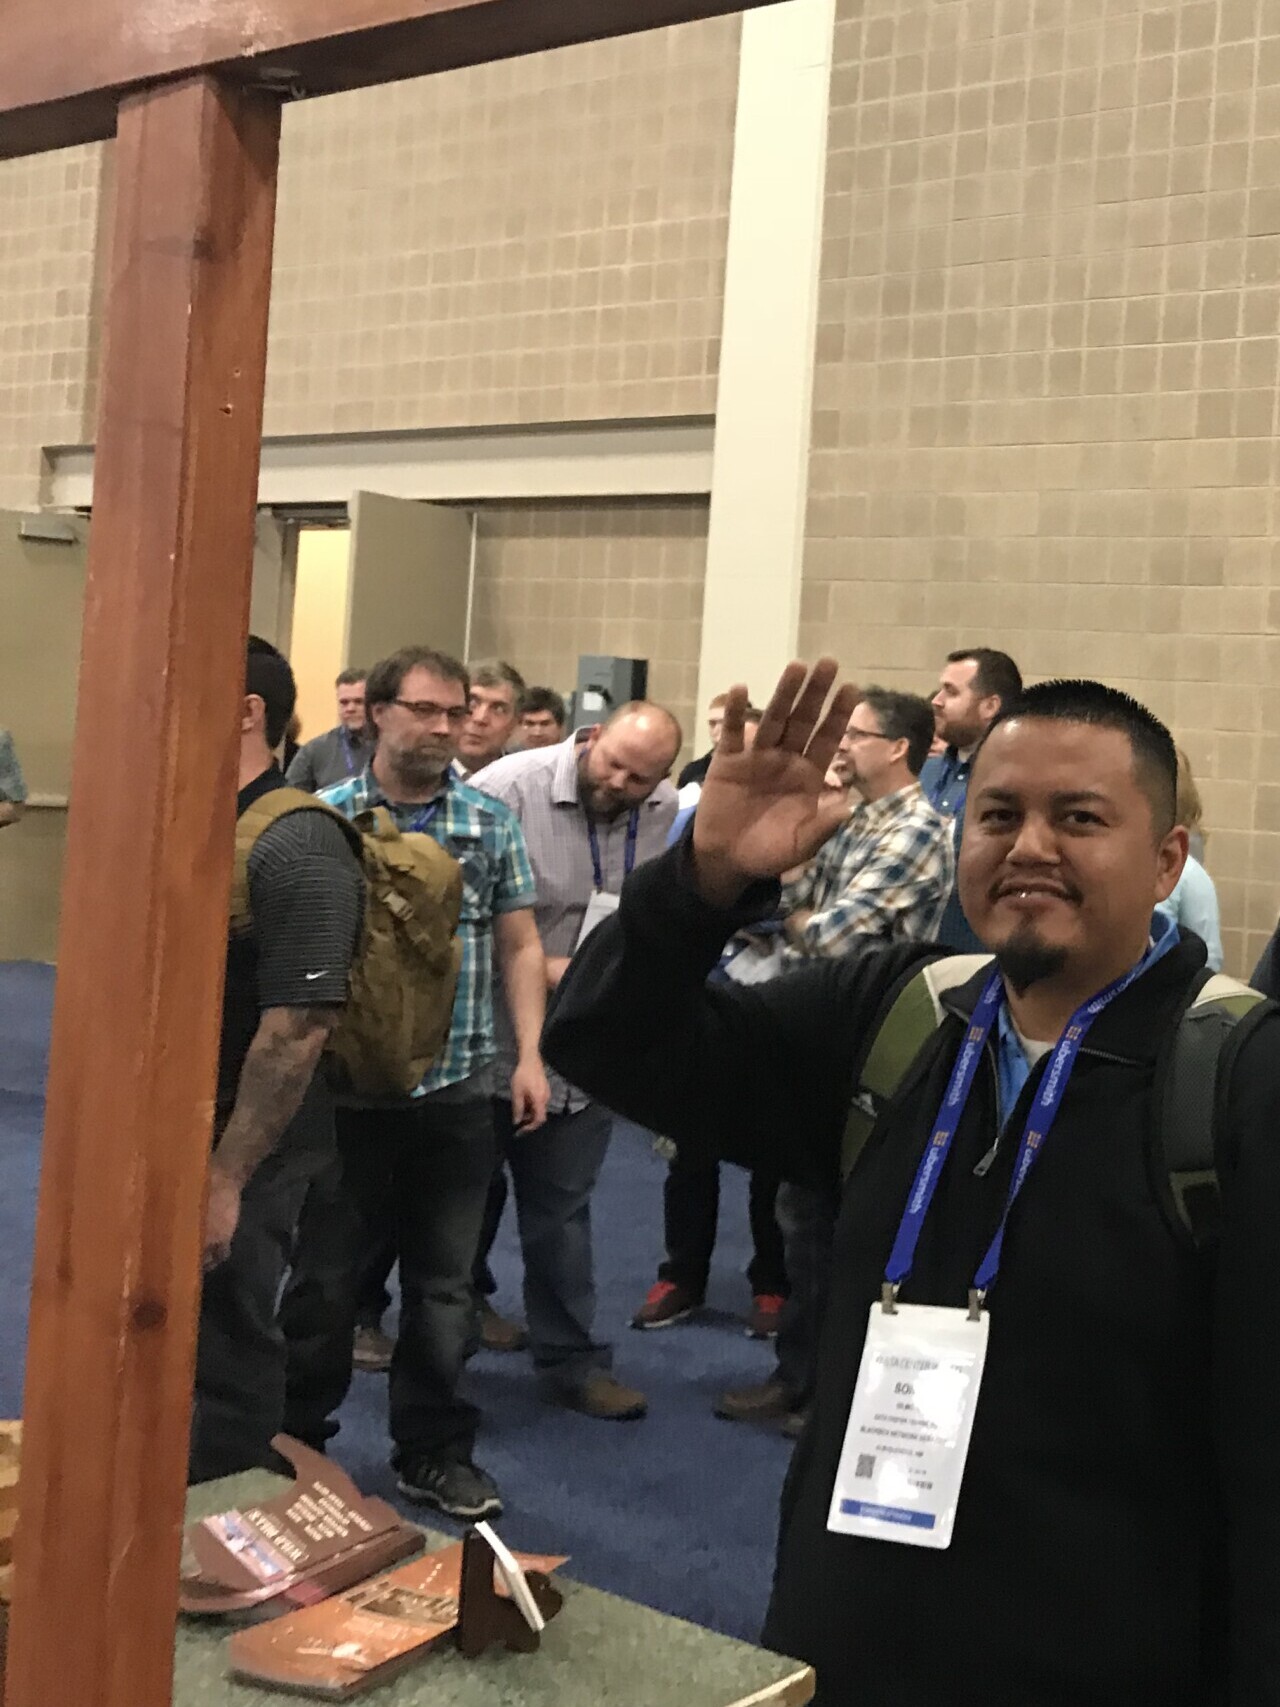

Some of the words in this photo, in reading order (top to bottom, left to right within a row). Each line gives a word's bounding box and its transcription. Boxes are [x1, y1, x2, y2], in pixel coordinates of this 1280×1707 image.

[947, 1042, 976, 1107] ubersmith
[1040, 1040, 1072, 1106] ubersmith
[909, 1146, 939, 1214] ubersmith
